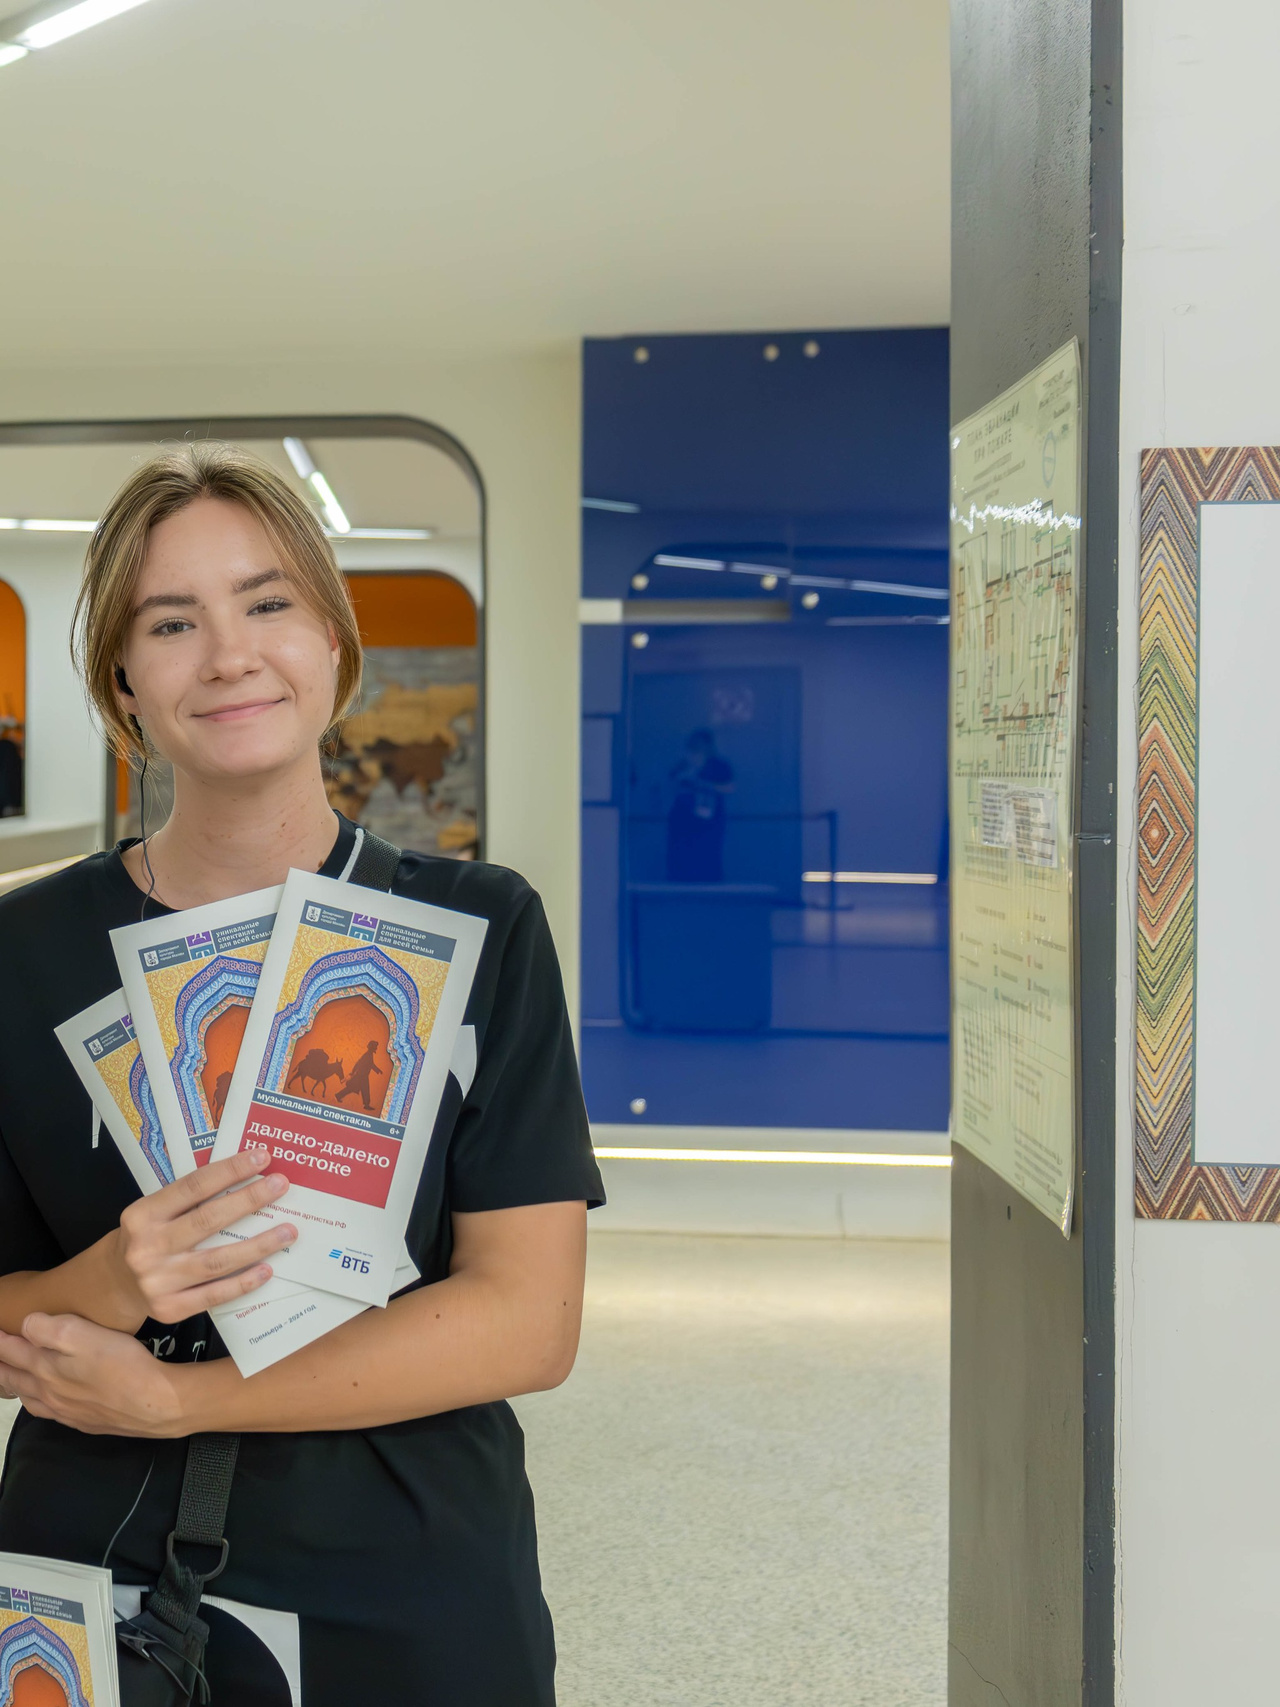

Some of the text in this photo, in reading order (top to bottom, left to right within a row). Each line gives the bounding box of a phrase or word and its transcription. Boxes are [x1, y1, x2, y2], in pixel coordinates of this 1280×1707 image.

[216, 921, 260, 937] уникальные
[217, 929, 256, 943] спектакли
[380, 930, 419, 945] спектакли
[381, 923, 427, 940] уникальные
[219, 941, 232, 949] для
[233, 936, 251, 946] всей
[378, 935, 435, 955] для всей семьи
[256, 1092, 400, 1135] музыкальный спектакль 6+
[246, 1121, 391, 1169] далеко-далеко
[272, 1145, 352, 1177] востоке
[301, 1213, 334, 1226] артистка
[334, 1220, 347, 1229] РФ
[341, 1255, 371, 1274] ВТБ
[249, 1323, 283, 1345] Премьера
[288, 1311, 304, 1324] 2024
[303, 1304, 317, 1314] год
